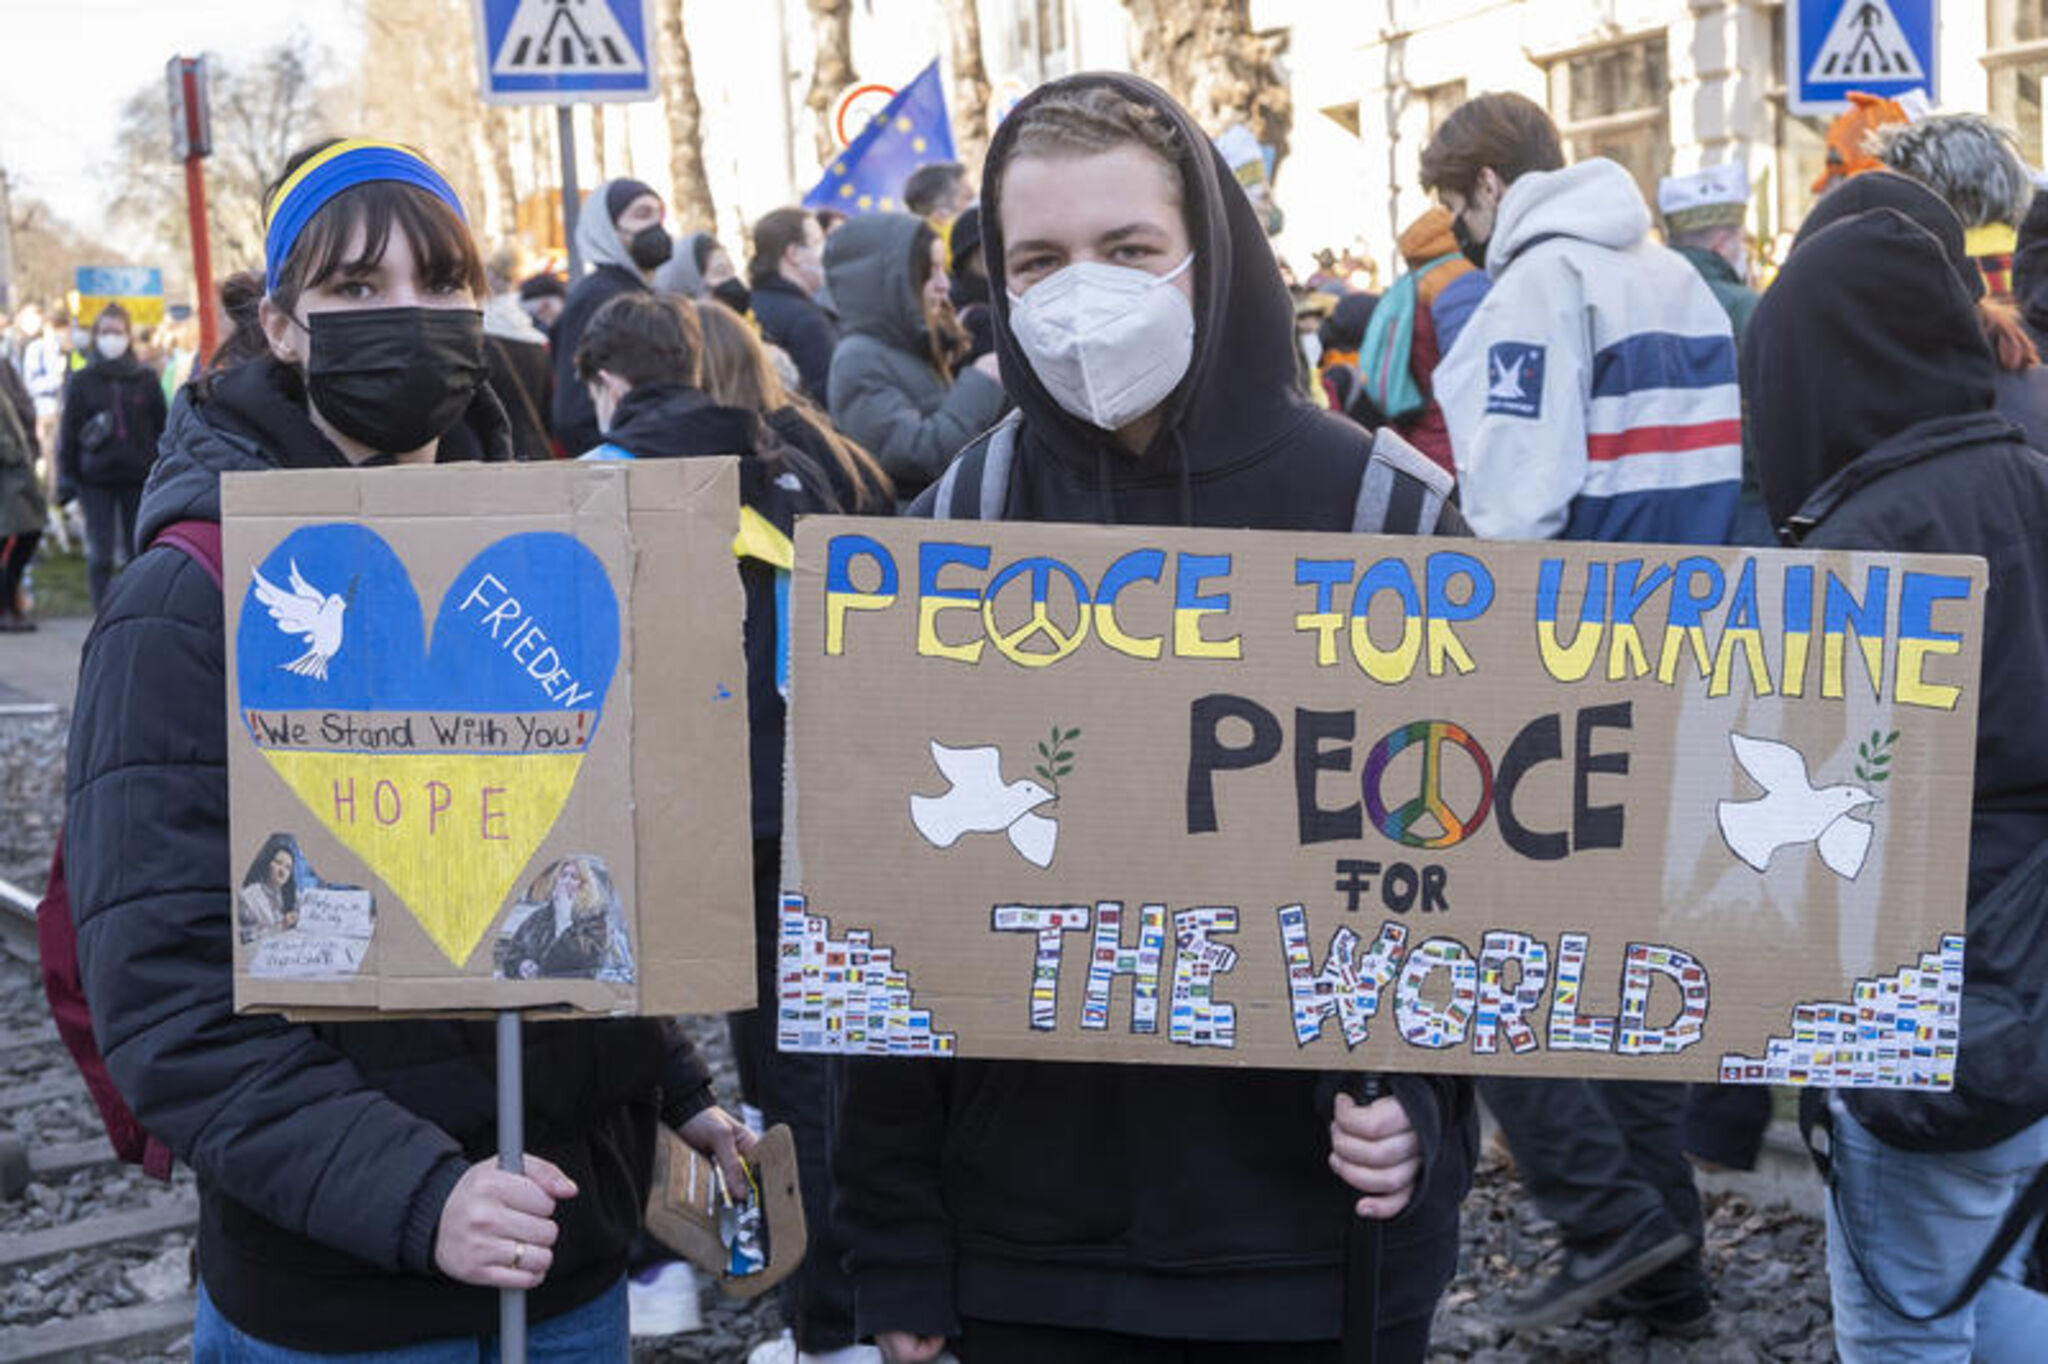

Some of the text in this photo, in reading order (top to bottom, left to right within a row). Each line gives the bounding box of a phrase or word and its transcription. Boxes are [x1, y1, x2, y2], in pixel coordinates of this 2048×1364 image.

[458, 573, 594, 710] FRIEDEN
[1536, 555, 1972, 711] UKRAINE
[321, 713, 415, 749] Stand
[430, 715, 508, 749] With
[520, 711, 586, 750] You!
[333, 778, 511, 841] HOPE
[1335, 859, 1450, 914] FOR
[991, 901, 1710, 1056] THE WORLD
